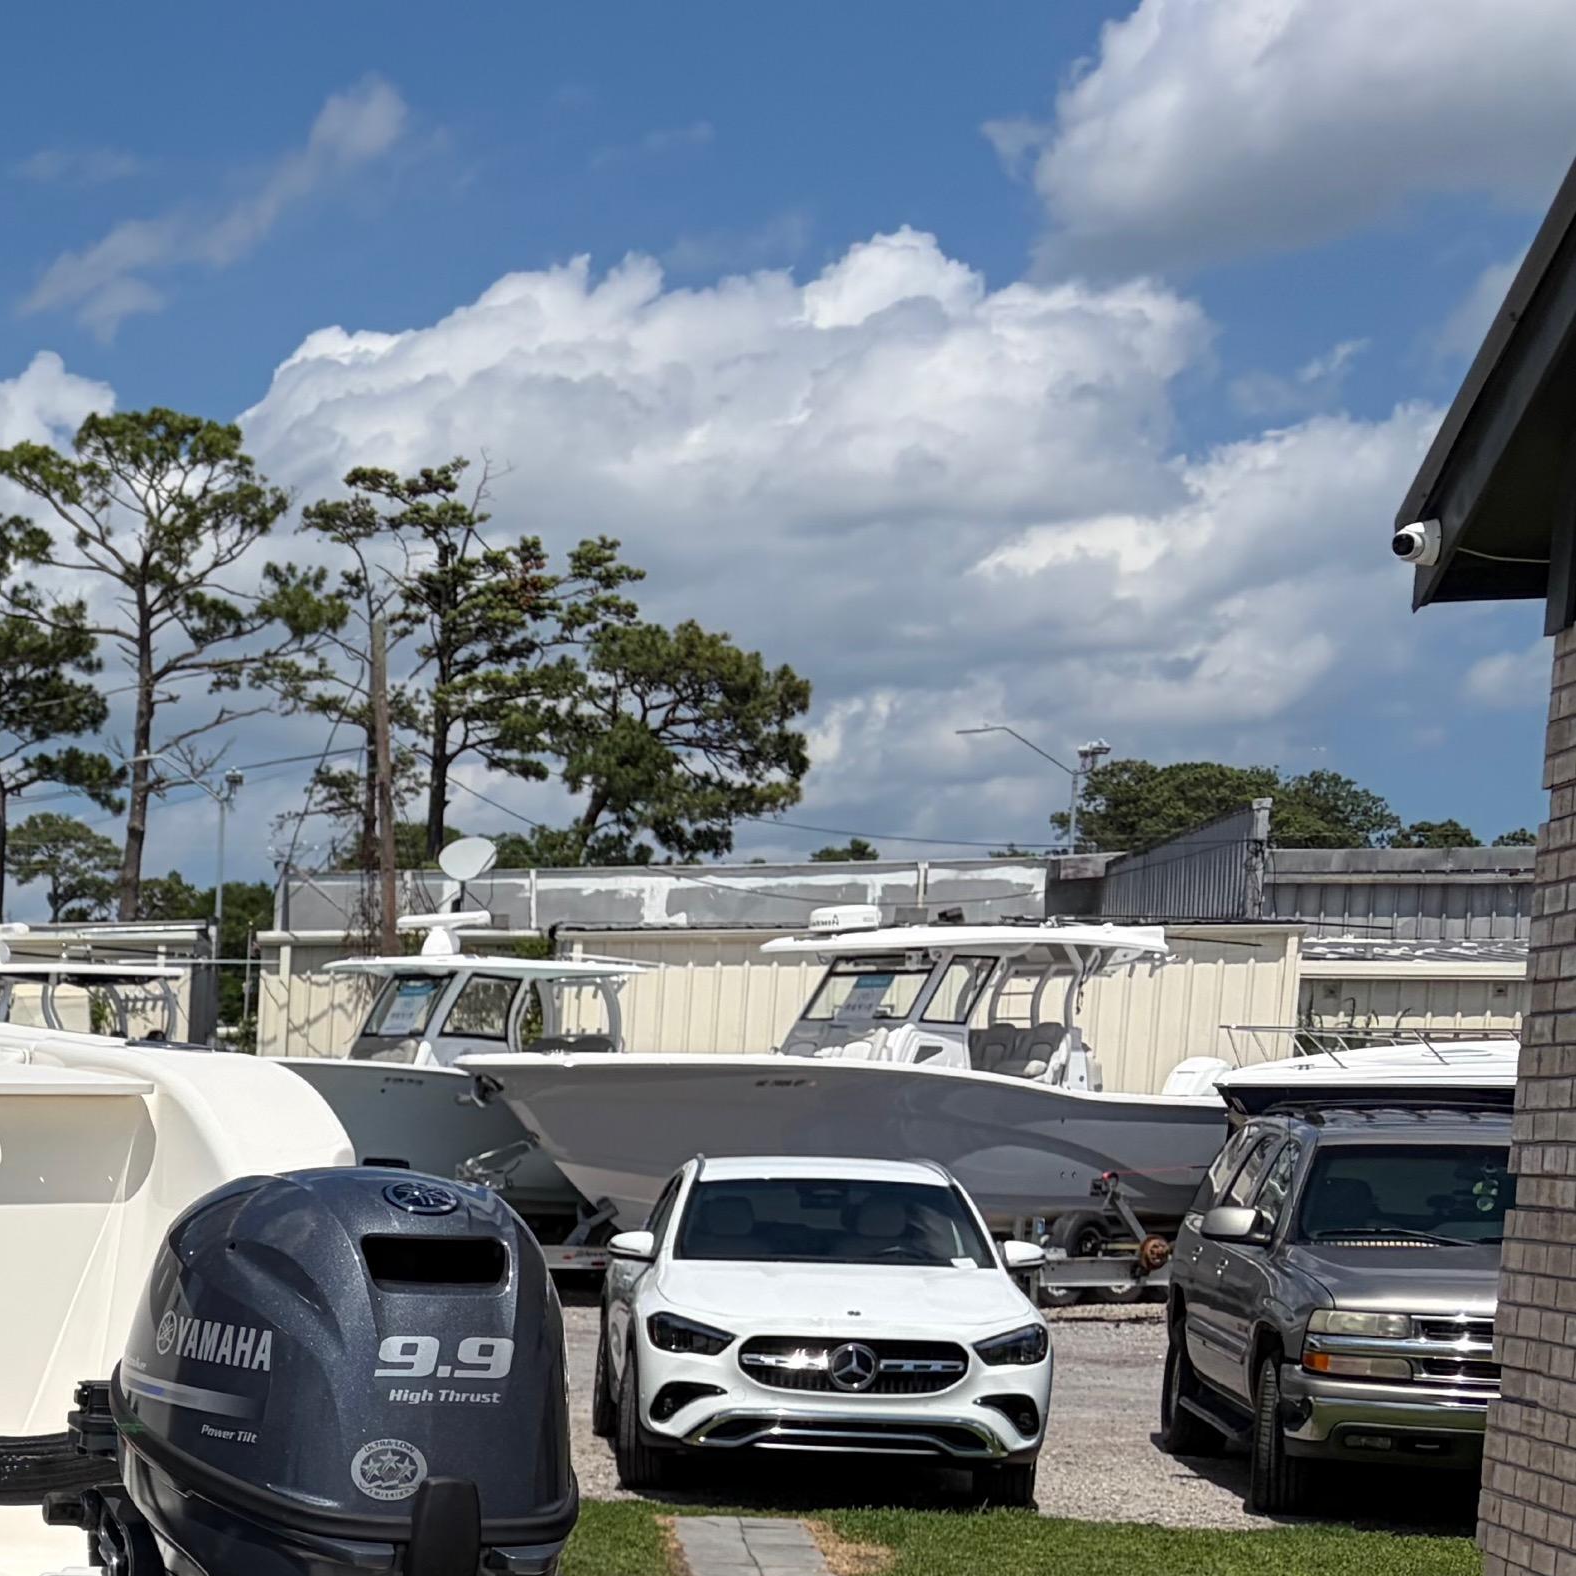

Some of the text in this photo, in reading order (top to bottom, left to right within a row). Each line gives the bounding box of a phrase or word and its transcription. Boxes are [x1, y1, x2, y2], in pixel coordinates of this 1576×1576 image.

[175, 1316, 273, 1371] YAMAHA
[374, 1335, 515, 1379] 9.9
[389, 1389, 502, 1405] High Thrust
[200, 1424, 258, 1444] Power Tilt
